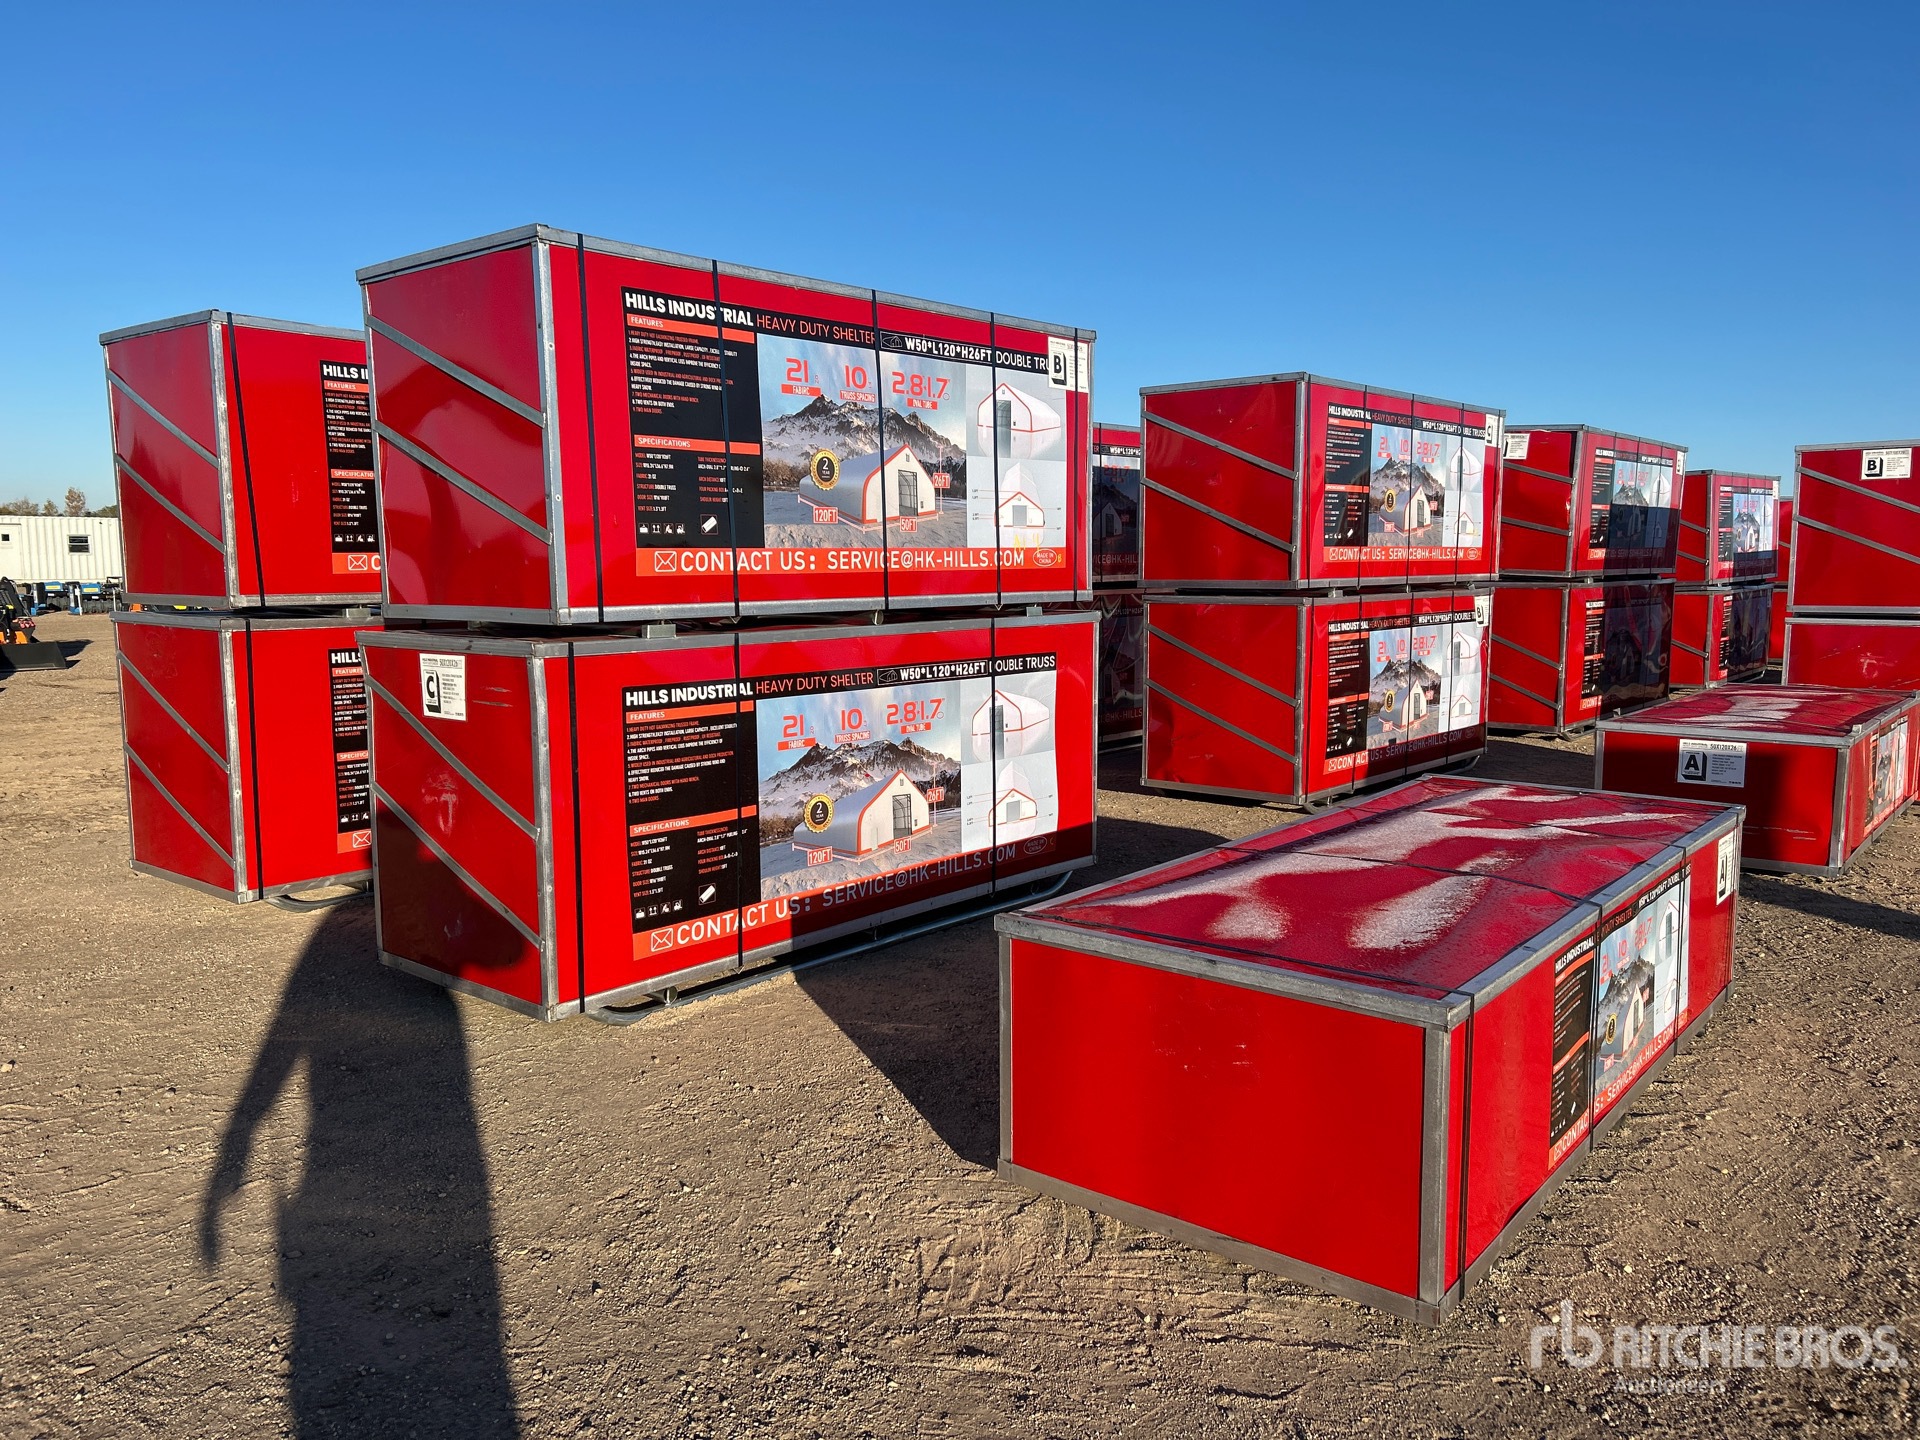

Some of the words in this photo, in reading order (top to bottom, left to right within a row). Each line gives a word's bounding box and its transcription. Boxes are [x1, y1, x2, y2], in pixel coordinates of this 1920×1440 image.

[625, 292, 666, 314] HILLS
[631, 316, 664, 328] FEATURES
[756, 314, 796, 334] HEAVY
[800, 321, 830, 339] DUTY
[996, 350, 1032, 369] DOUBLE
[1034, 355, 1049, 371] TRU
[1053, 355, 1063, 374] B
[323, 364, 359, 380] HILLS
[785, 357, 809, 383] 21
[845, 365, 868, 389] 10
[841, 391, 856, 401] TRUSS
[856, 392, 875, 403] SPACING
[1328, 405, 1341, 416] HILLS
[1341, 407, 1372, 420] INDUSTRAL
[1398, 417, 1412, 426] SHELTE
[1457, 425, 1472, 436] DUBLE
[638, 437, 691, 448] SPECIFICATIONS
[822, 458, 829, 470] 2
[1867, 459, 1877, 471] B
[334, 470, 374, 478] SPECIFICATIO
[934, 474, 950, 488] 26FT
[814, 509, 838, 522] 120FT
[900, 518, 917, 531] 50FT
[680, 551, 774, 572] CONTACT
[780, 551, 816, 571] US:
[827, 550, 1025, 570] SERVICE@HK-HILLS.COM
[1338, 547, 1370, 560] CONTACT
[1328, 623, 1341, 633] HILLS
[1341, 620, 1369, 631] INDUSTIAL
[1025, 655, 1056, 670] TRUSS
[426, 675, 435, 699] C
[756, 678, 793, 694] HEAVY
[797, 675, 828, 691] DUTY
[830, 672, 874, 687] SHELTER
[626, 689, 669, 707] HILLS
[671, 682, 753, 703] INDUSTRIAL
[630, 711, 665, 721] FEATURES
[841, 708, 863, 731] 10
[782, 714, 805, 738] 21
[836, 733, 851, 743] TRUSS
[852, 731, 870, 741] SPACING
[1684, 754, 1700, 771] A
[927, 788, 944, 801] 26FT
[816, 802, 823, 814] 2
[634, 819, 690, 834] SPECIFICATIONS
[894, 838, 911, 852] 50FT
[808, 848, 832, 864] 120FT
[1719, 858, 1726, 884] A
[677, 904, 769, 945] CONTACT
[776, 896, 811, 918] US:
[822, 844, 1017, 907] SERVICE@HK-HILLS.COM
[1555, 954, 1567, 974] HILLS
[1566, 935, 1595, 964] INDUSTRIAL
